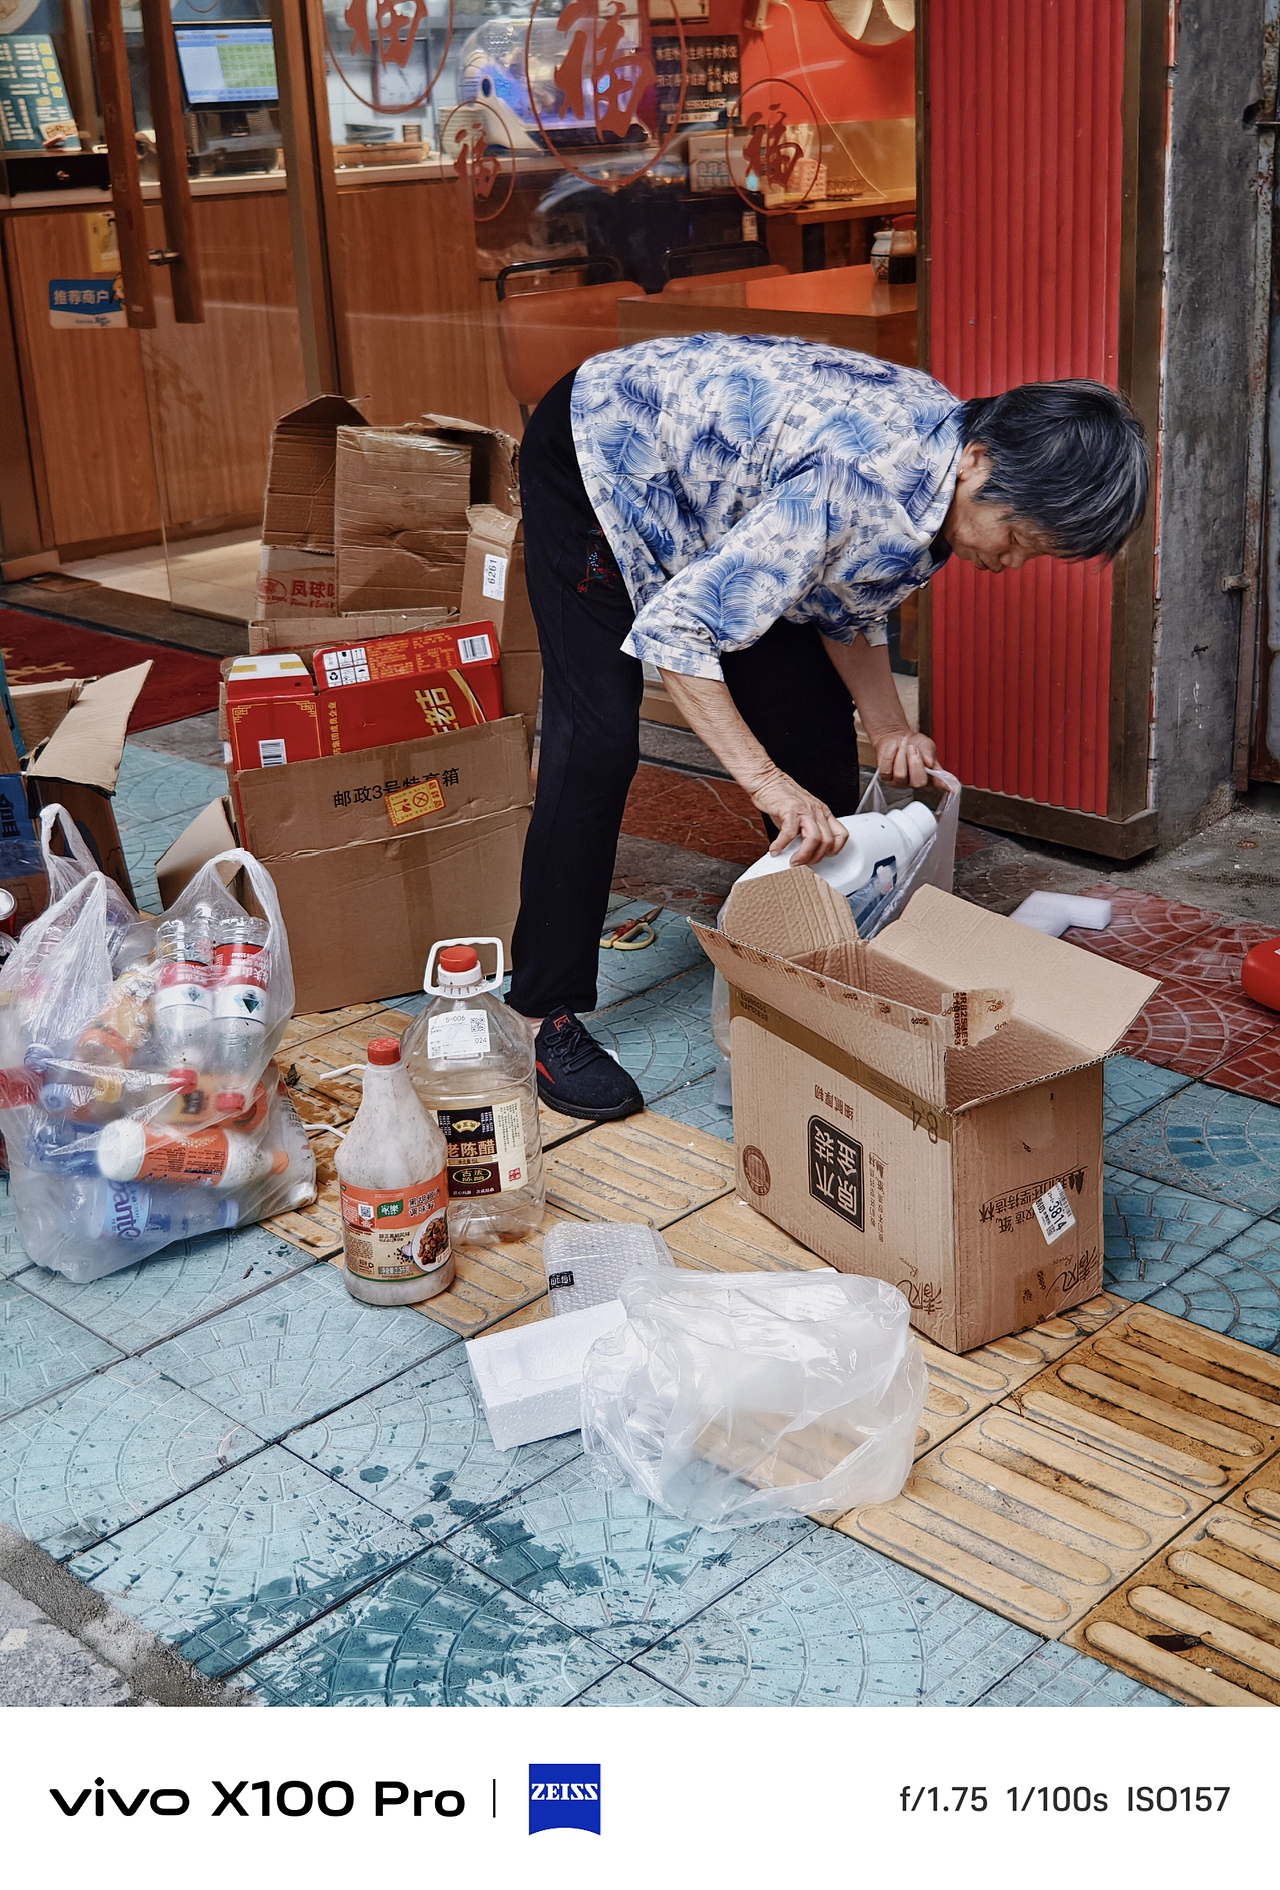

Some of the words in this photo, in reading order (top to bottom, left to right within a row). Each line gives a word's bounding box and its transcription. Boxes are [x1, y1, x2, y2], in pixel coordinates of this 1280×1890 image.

[554, 0, 656, 143] 福
[453, 122, 501, 199] 福
[742, 103, 804, 192] 福
[53, 289, 110, 305] 推荐商户
[487, 558, 498, 585] 6261
[445, 1015, 466, 1023] S-006
[813, 1084, 854, 1122] 细腻厚韧
[447, 1138, 496, 1158] 老陈醋
[814, 1125, 857, 1177] 金装
[814, 1161, 857, 1217] 原木
[1048, 1200, 1068, 1231] 3814
